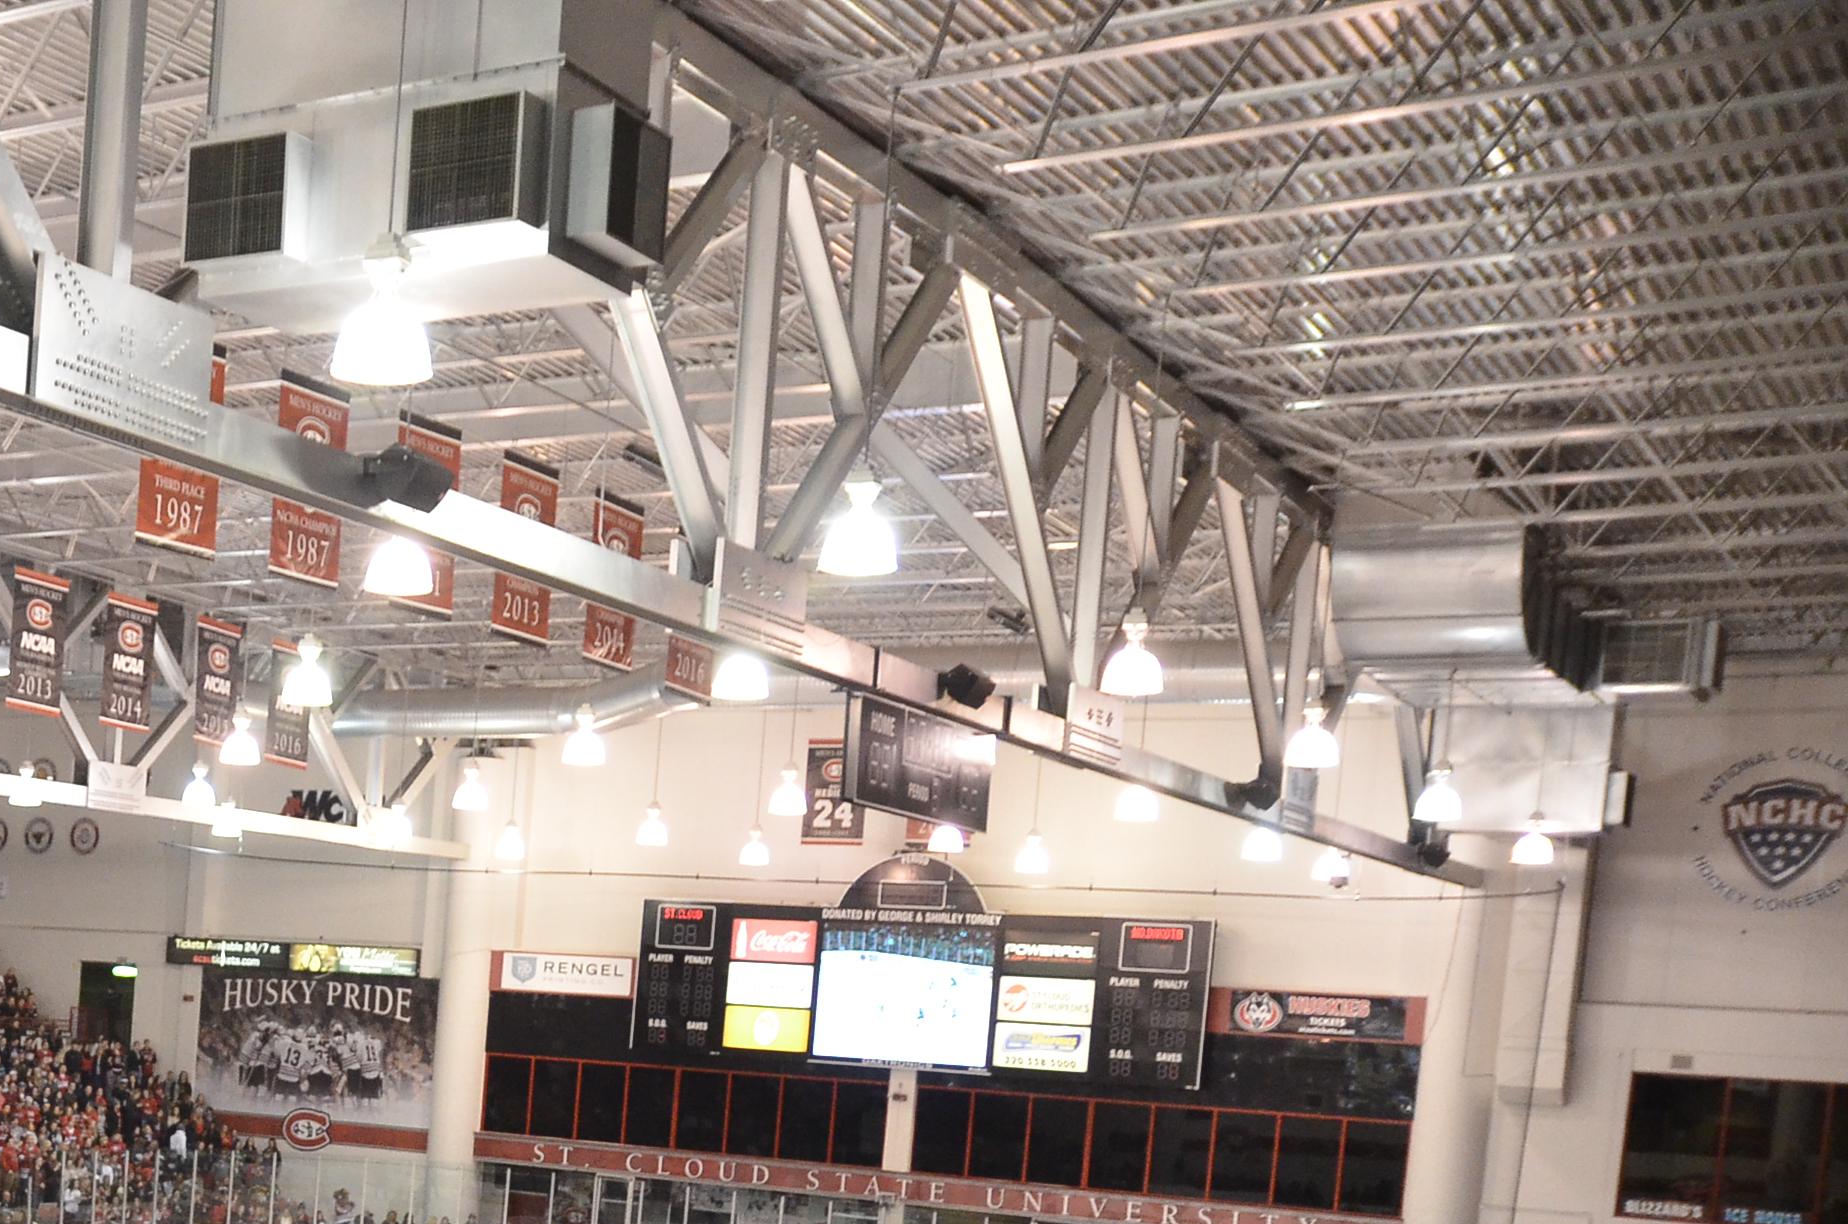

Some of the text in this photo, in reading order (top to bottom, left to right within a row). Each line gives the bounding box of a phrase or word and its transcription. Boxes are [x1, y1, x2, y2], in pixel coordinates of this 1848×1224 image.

[155, 474, 206, 498] THIRD PLACE
[155, 494, 203, 534] 1987
[286, 529, 330, 568] 1987
[503, 592, 540, 626] 2013
[20, 631, 56, 655] NCAA
[112, 653, 145, 676] NCAA
[17, 674, 52, 700] 2013
[203, 674, 231, 697] NCAA
[110, 693, 142, 718] 2014
[870, 710, 897, 737] HOME
[273, 733, 302, 755] 2016
[907, 781, 930, 802] PERIOD
[812, 799, 854, 829] 24
[1728, 799, 1845, 831] NCHC
[901, 854, 930, 866] PERIOD
[822, 908, 862, 919] DONATED
[864, 909, 876, 920] BY
[877, 910, 911, 922] GEORGE
[915, 912, 923, 922] &
[924, 912, 963, 925] SHIRLEY
[175, 938, 205, 950] Tickets
[244, 942, 269, 955] 24/7
[543, 961, 624, 977] RENGEL
[648, 954, 713, 965] PLAYER PENALTY
[1109, 977, 1190, 990] PLAYER PENALTY
[222, 978, 413, 1023] HUSKY PRIDE
[1288, 995, 1371, 1019] HUSKIES
[686, 1021, 708, 1031] SAVES
[1155, 1052, 1183, 1063] SAVES
[533, 1143, 590, 1168] ST.
[625, 1151, 771, 1186] CLOUD
[805, 1170, 946, 1203] STATE
[1724, 1208, 1749, 1223] ICE
